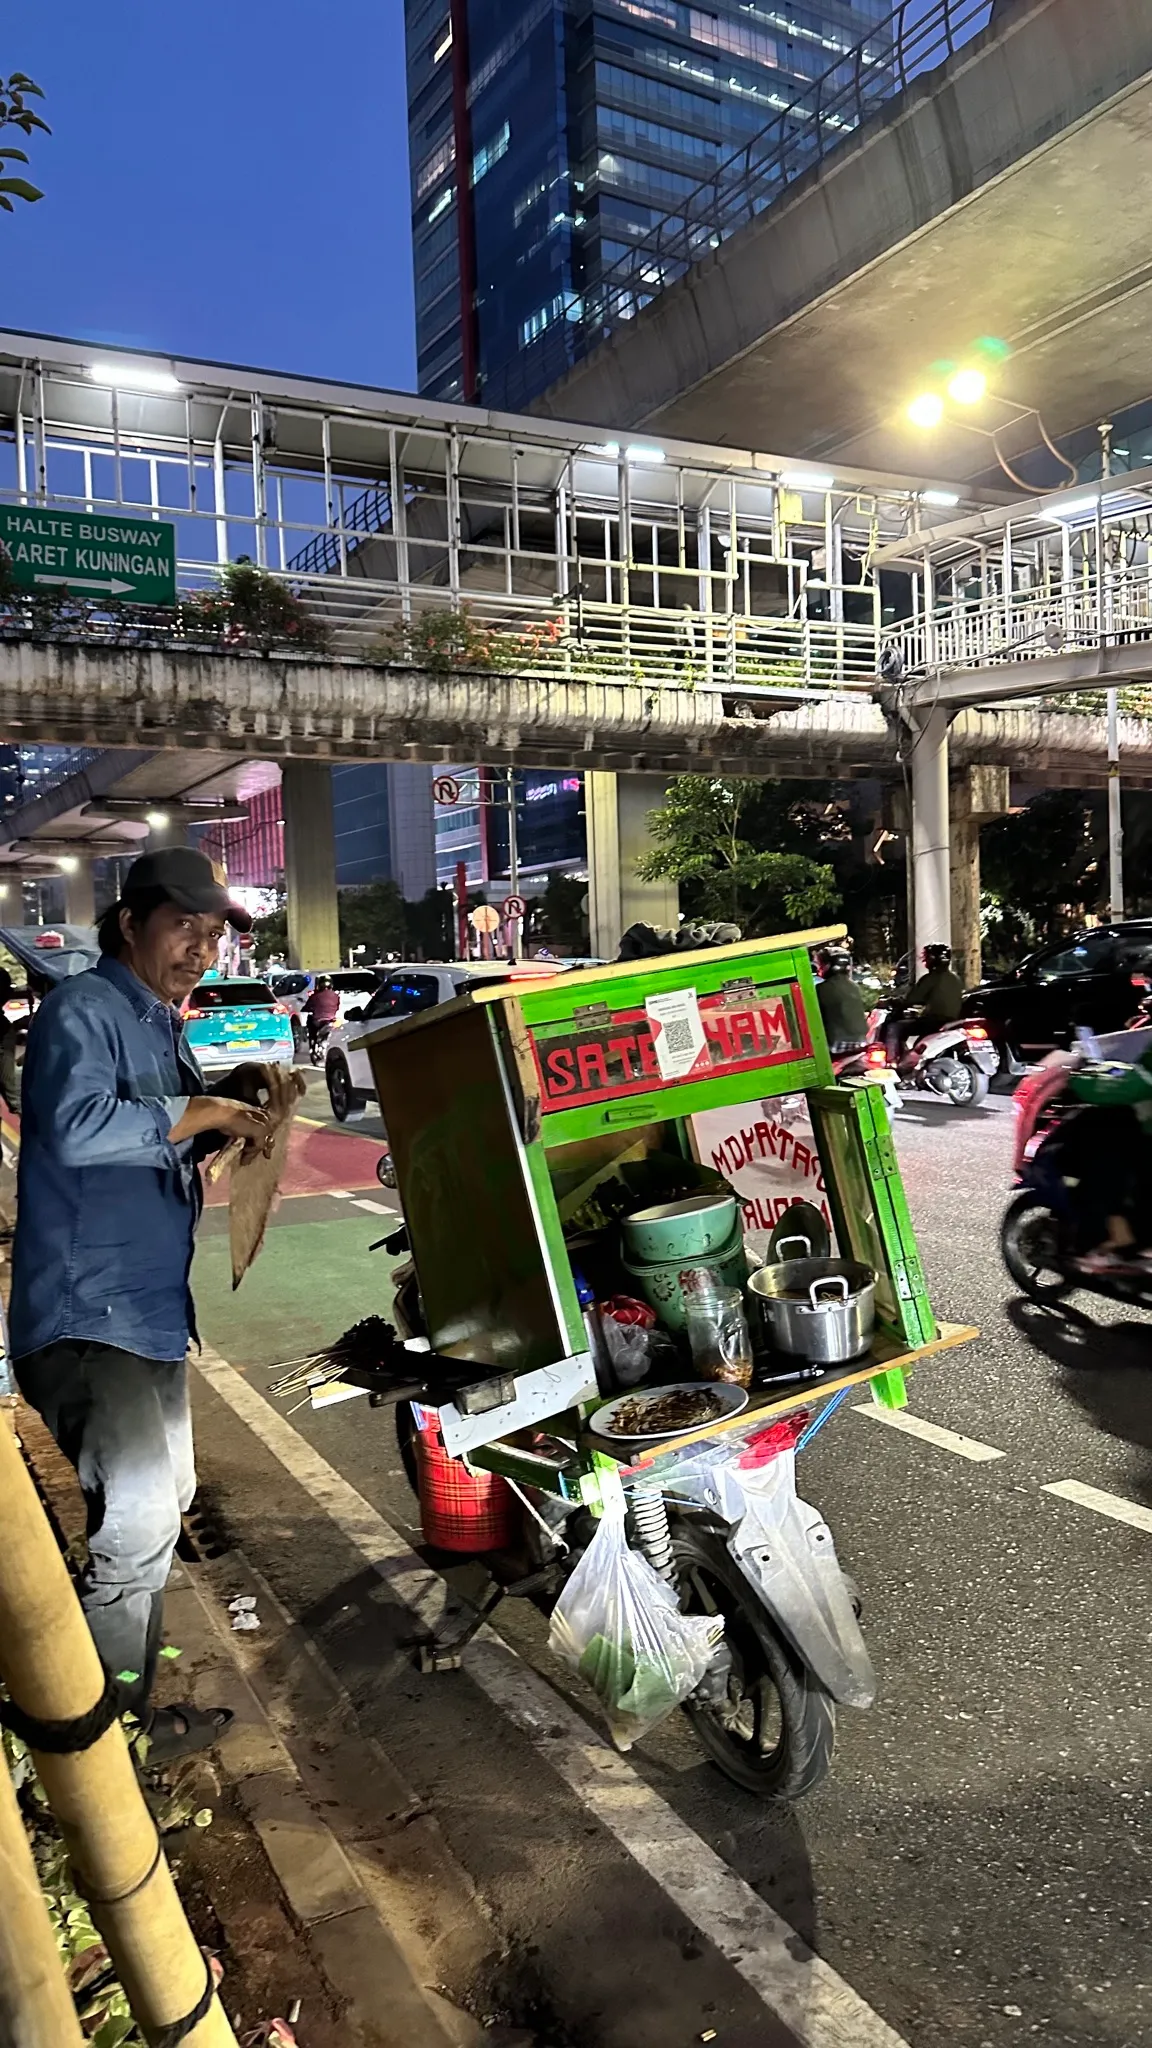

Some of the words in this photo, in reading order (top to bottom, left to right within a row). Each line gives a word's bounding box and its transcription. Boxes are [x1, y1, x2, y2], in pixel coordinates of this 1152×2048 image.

[7, 516, 73, 538] HALTE
[79, 524, 162, 547] BUSWAY
[2, 541, 68, 567] KARET
[76, 548, 169, 577] KUNINGAN
[702, 1003, 791, 1059] YAM
